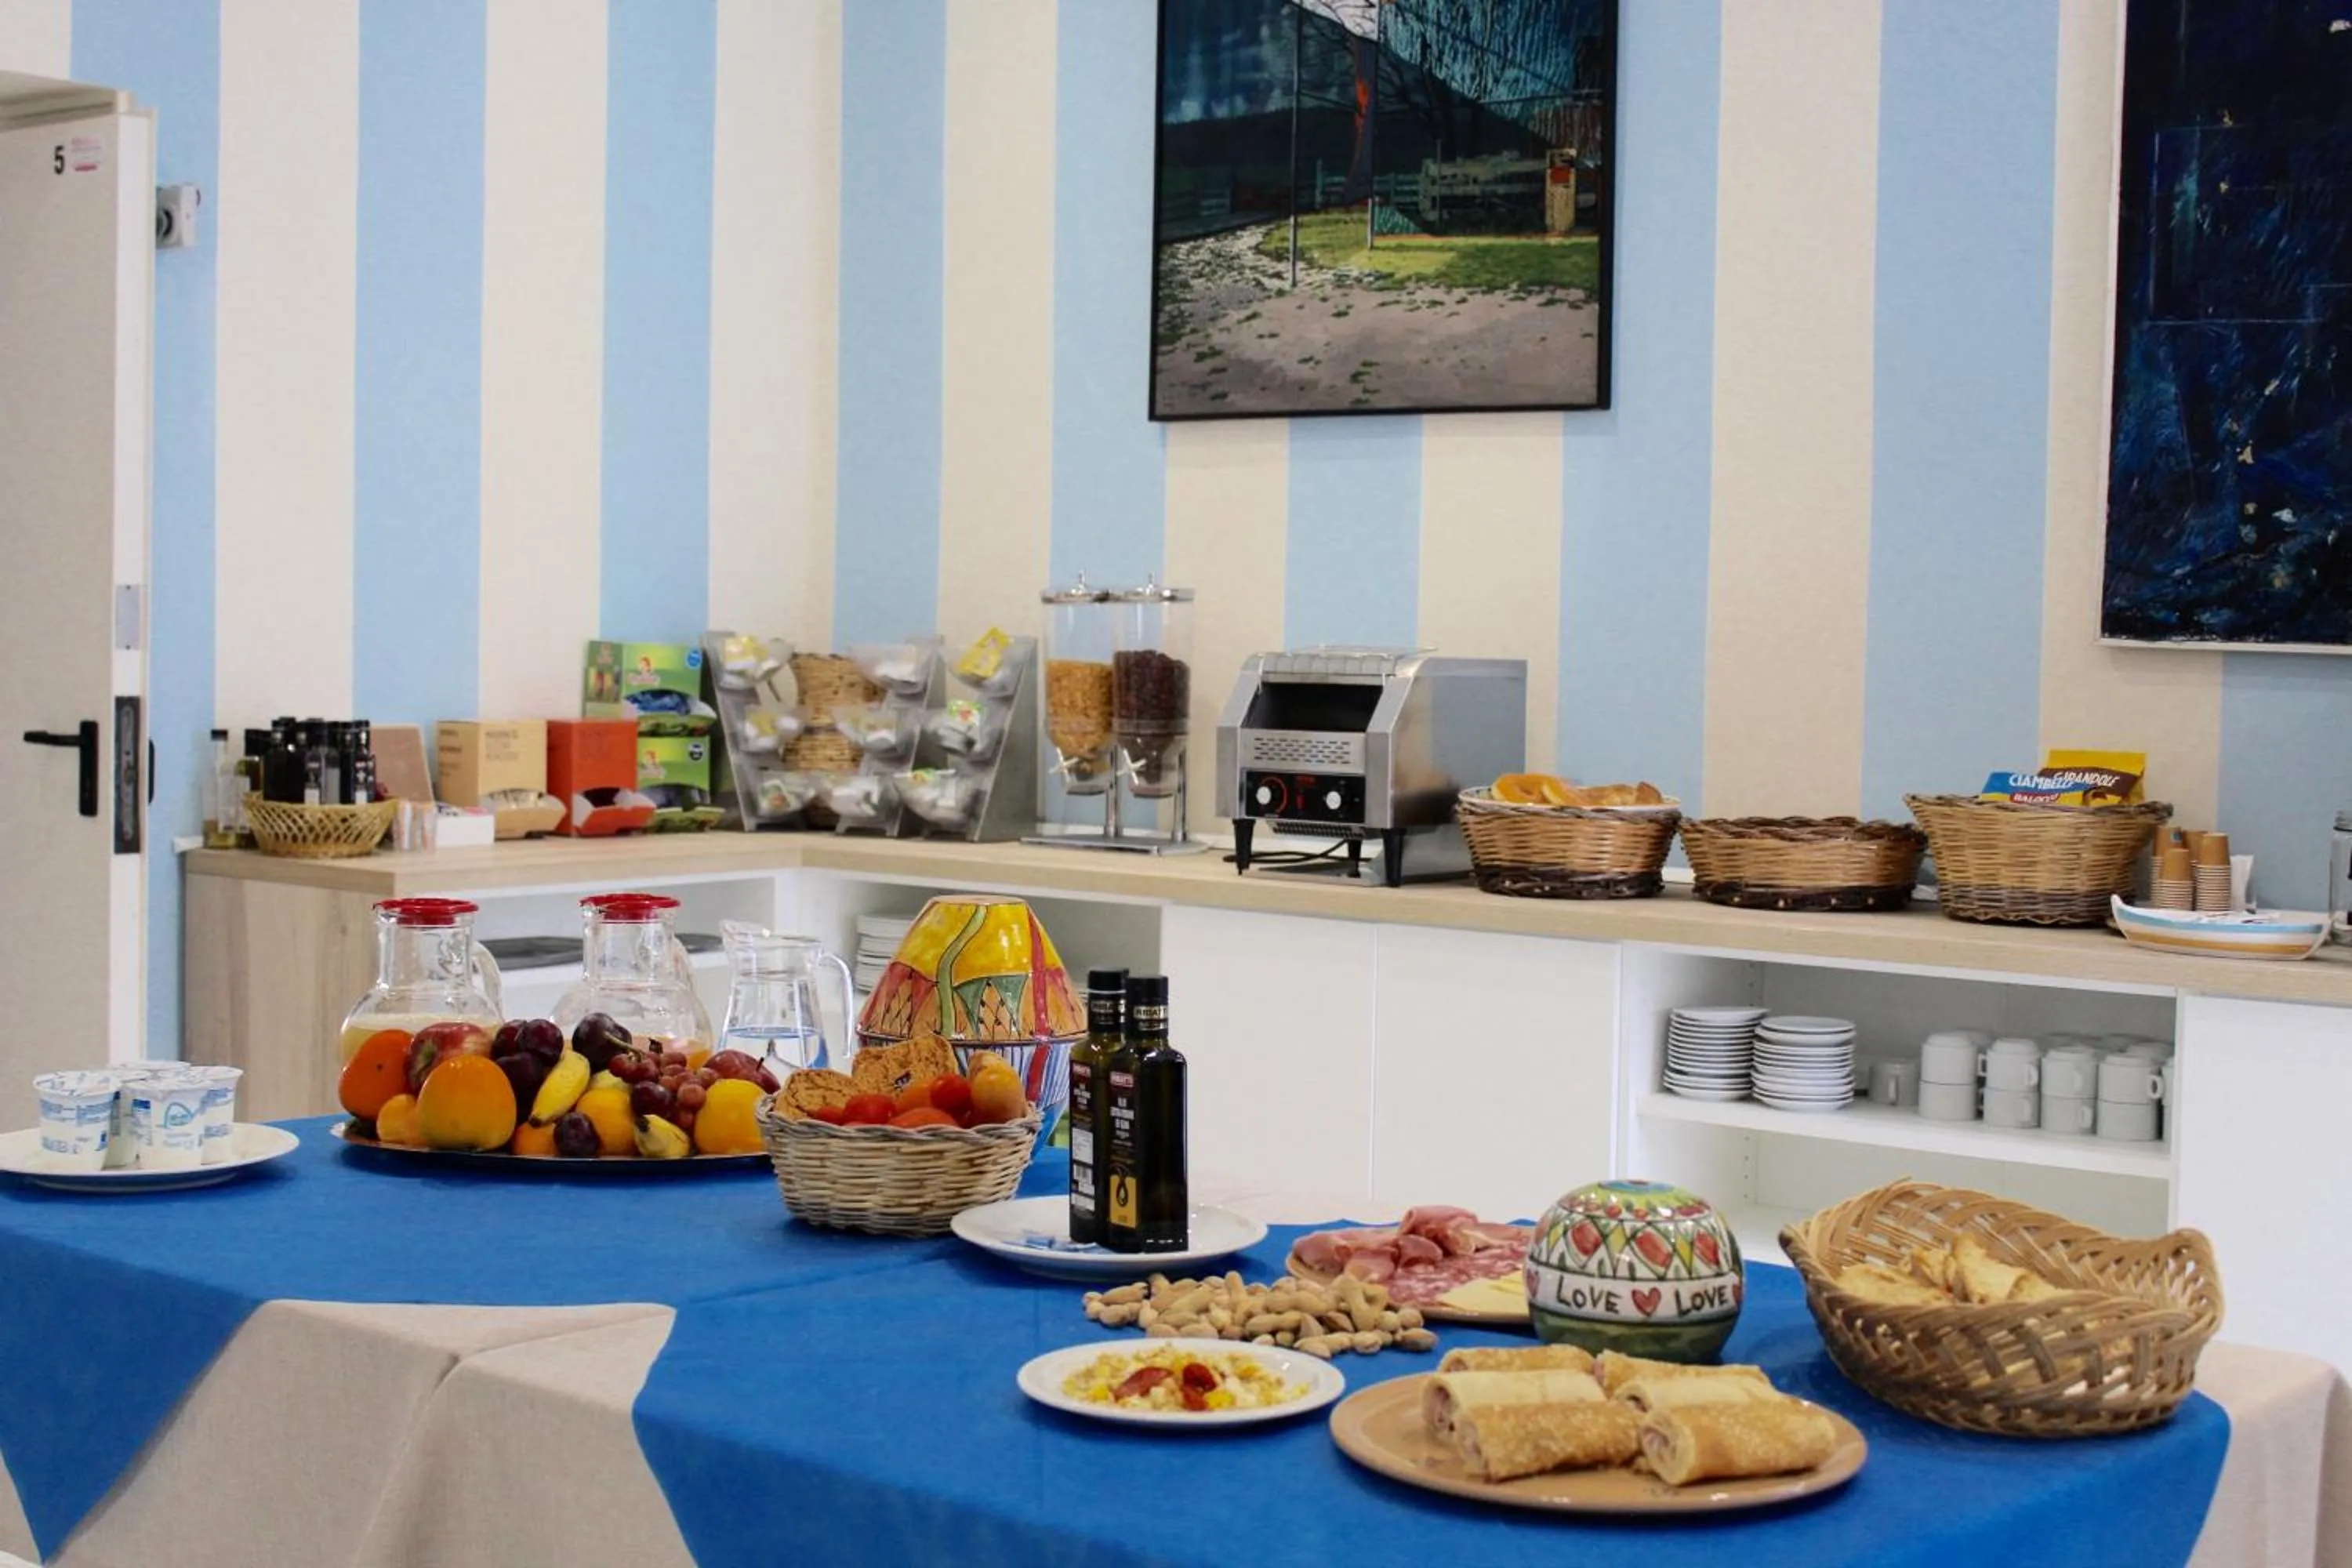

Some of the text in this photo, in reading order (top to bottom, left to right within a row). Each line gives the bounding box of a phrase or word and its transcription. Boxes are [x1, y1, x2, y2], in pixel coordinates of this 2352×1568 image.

[54, 145, 64, 175] 5
[1556, 1275, 1728, 1317] LOVE LOVE
